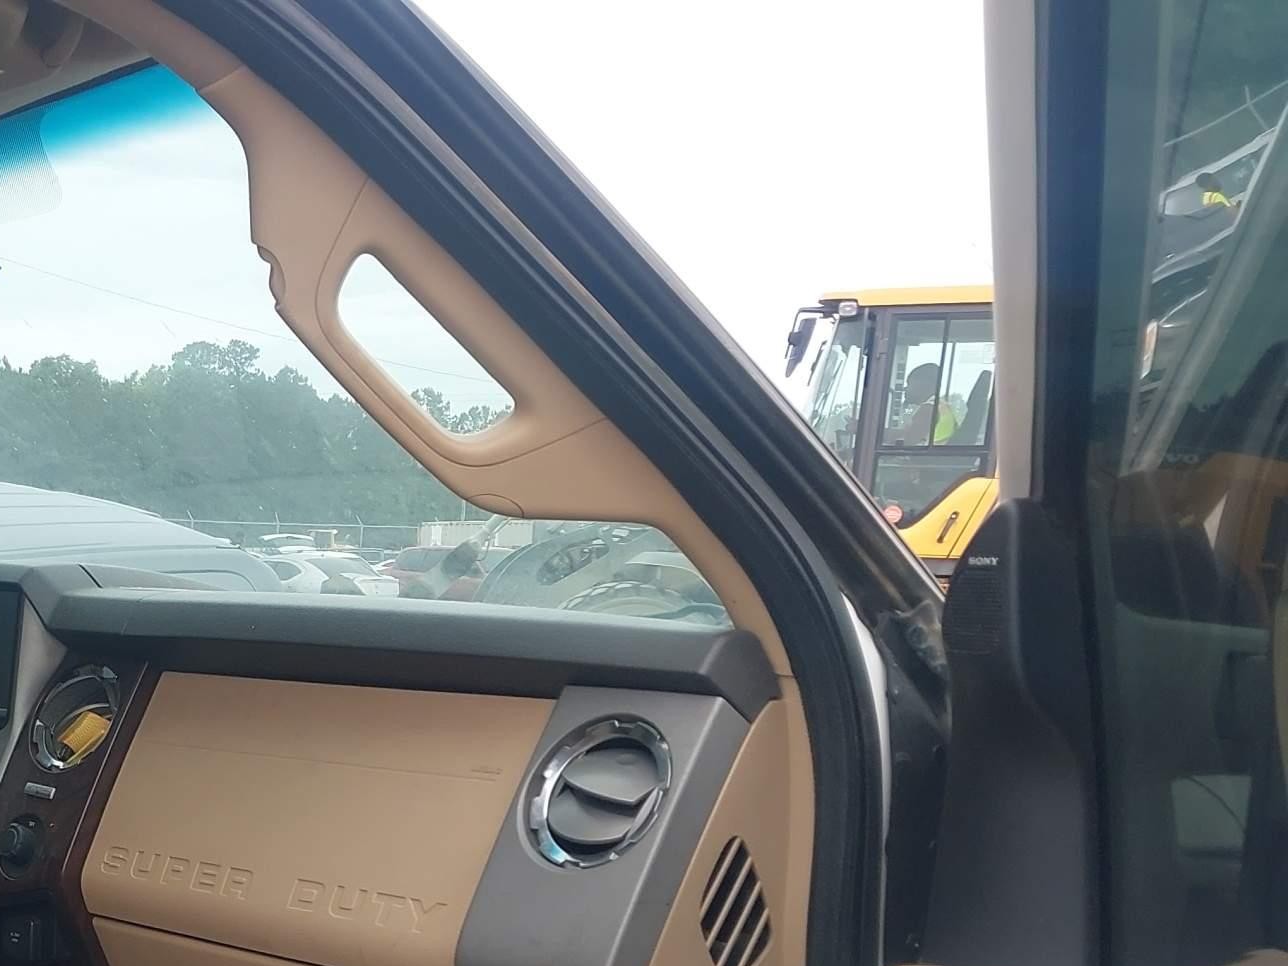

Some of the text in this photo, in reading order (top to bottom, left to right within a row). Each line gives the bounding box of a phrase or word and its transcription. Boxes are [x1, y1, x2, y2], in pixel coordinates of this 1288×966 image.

[968, 556, 999, 566] SONY
[100, 846, 448, 934] SUPER DUTY
